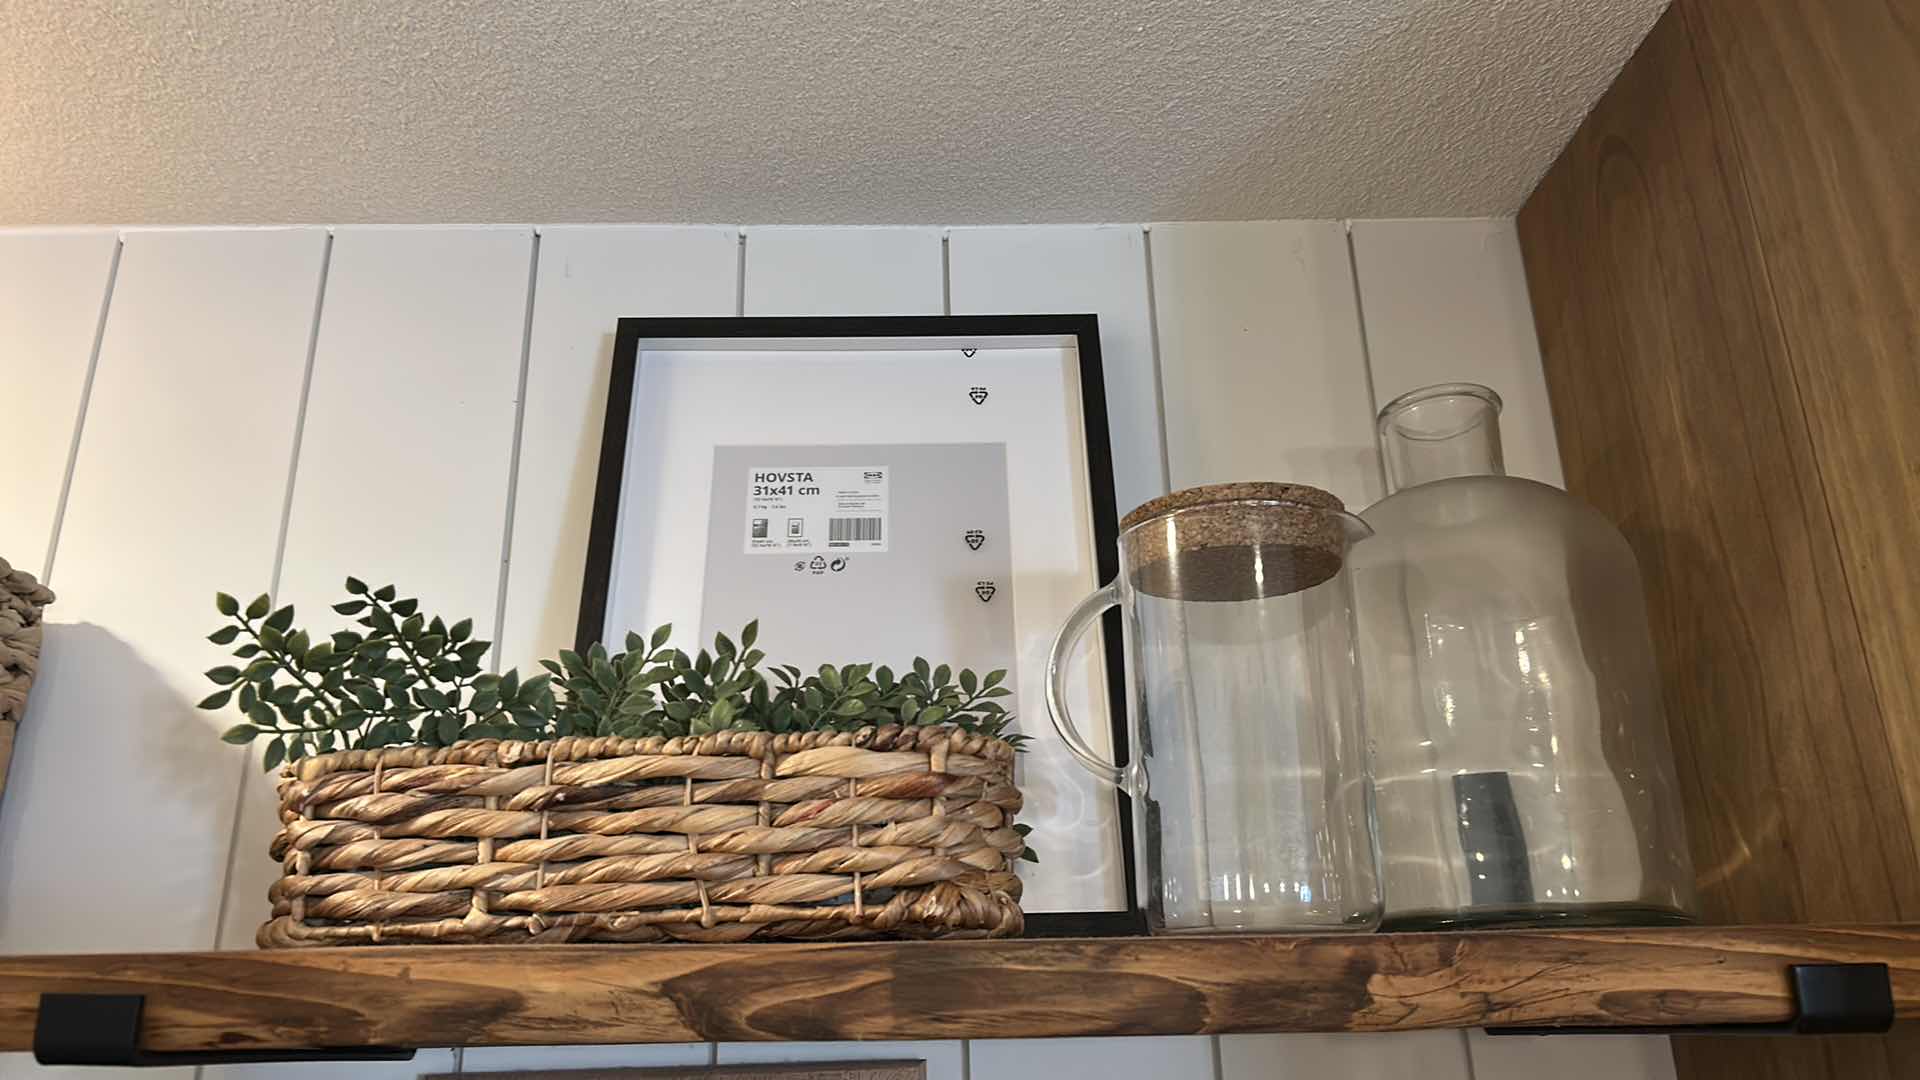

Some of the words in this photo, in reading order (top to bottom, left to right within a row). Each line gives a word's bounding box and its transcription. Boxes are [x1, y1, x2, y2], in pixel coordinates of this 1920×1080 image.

[754, 472, 814, 482] HOVSTA
[752, 485, 793, 495] 31x41
[798, 487, 820, 495] cm
